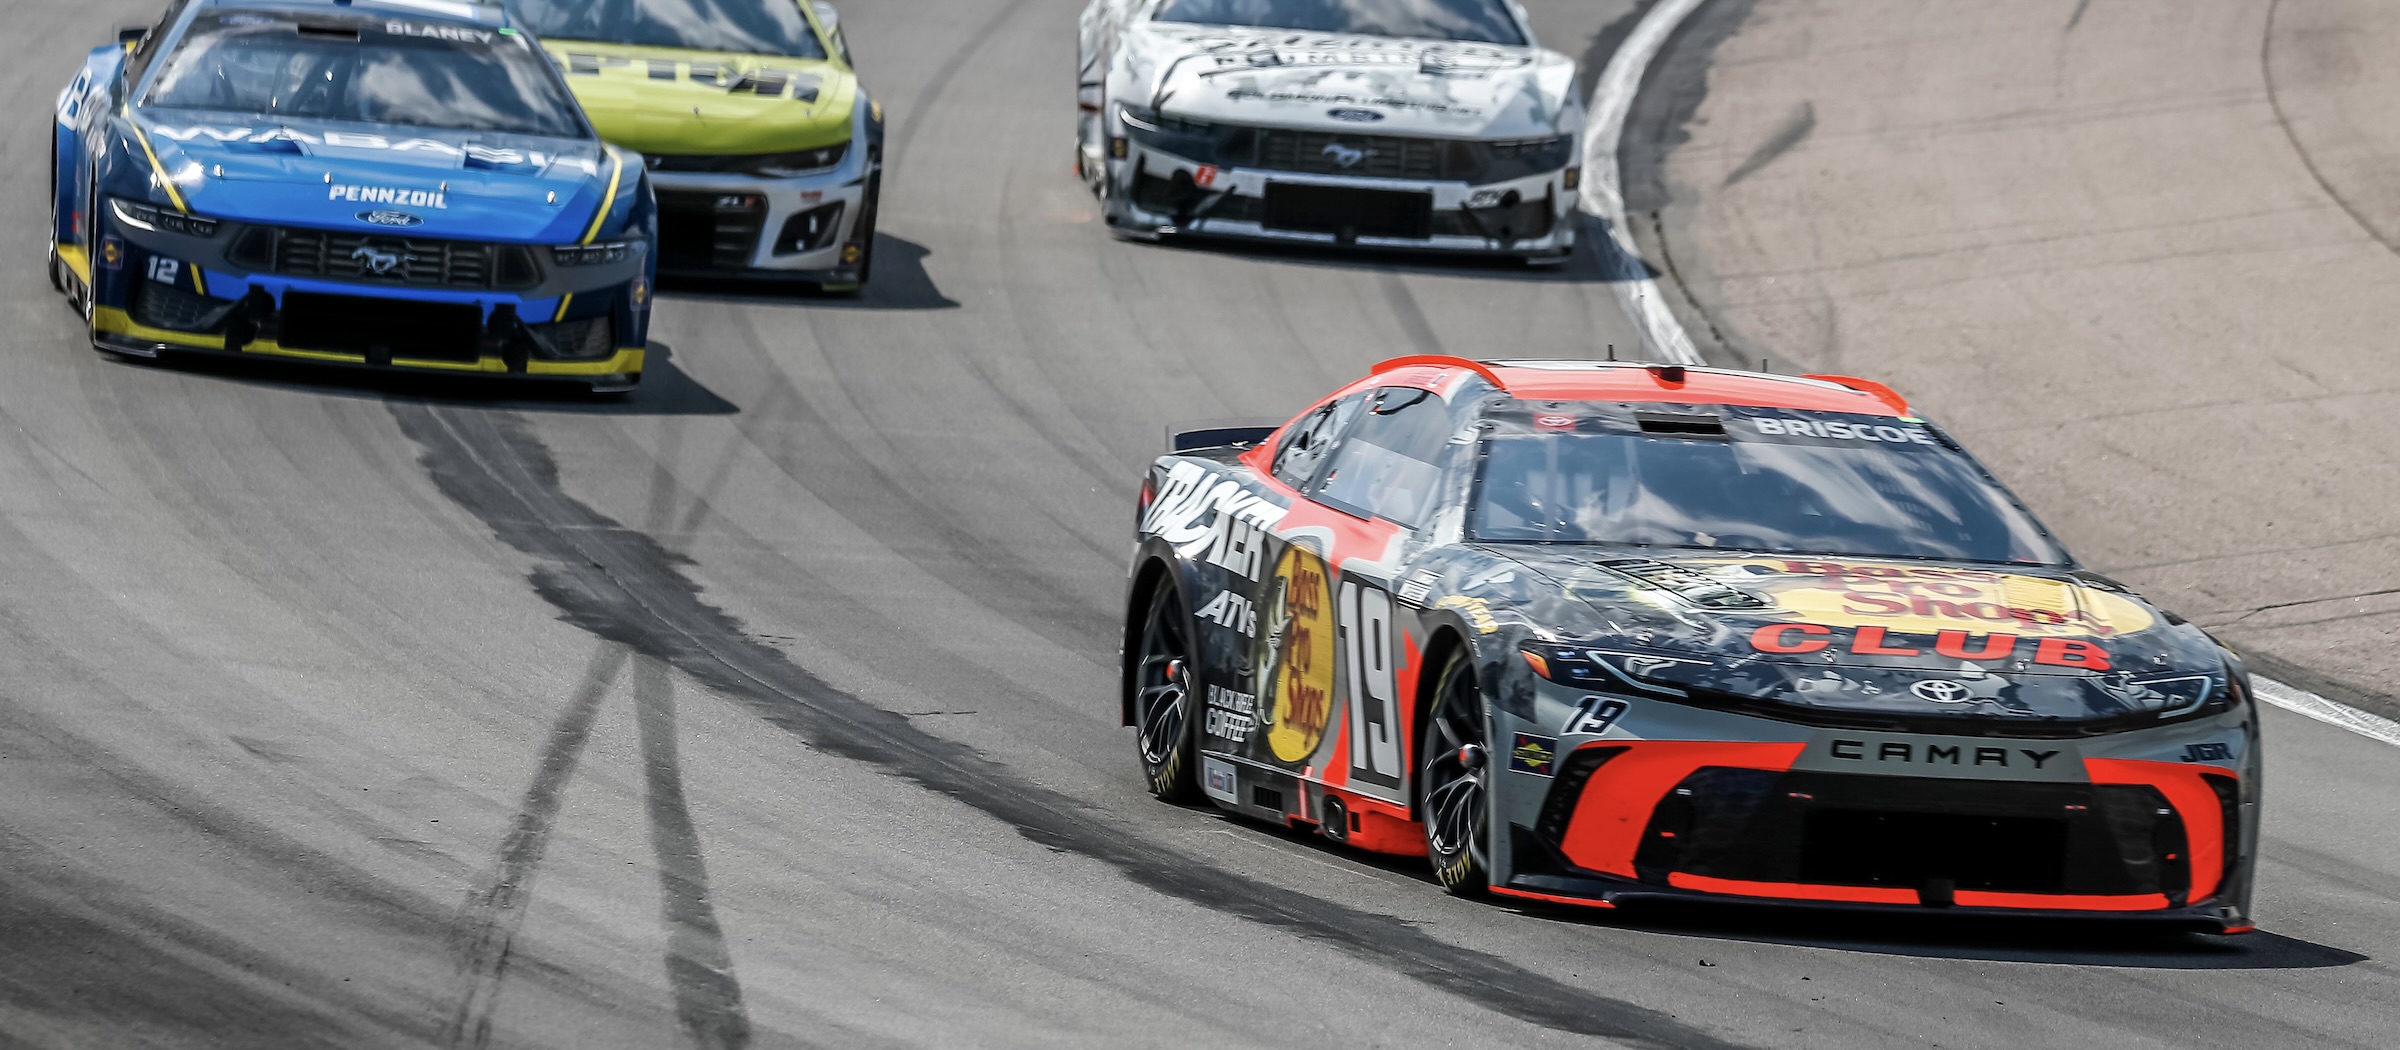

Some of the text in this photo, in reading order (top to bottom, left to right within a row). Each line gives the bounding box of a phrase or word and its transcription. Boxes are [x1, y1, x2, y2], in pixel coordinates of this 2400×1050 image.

[386, 22, 492, 43] BLANEY
[153, 125, 597, 176] WABASH
[329, 184, 447, 209] PENNZOIL
[147, 255, 179, 285] 12
[1751, 417, 1935, 445] BRISCOE
[1139, 460, 1290, 583] TRACKER
[1782, 560, 1998, 584] Bass
[1820, 575, 1983, 599] Pro
[1194, 590, 1258, 639] ATVs
[1750, 623, 2111, 671] CLUB
[1339, 580, 1400, 779] 19
[1561, 695, 1631, 735] 19
[1830, 739, 2061, 769] CAMRY
[2179, 742, 2235, 762] JGR
